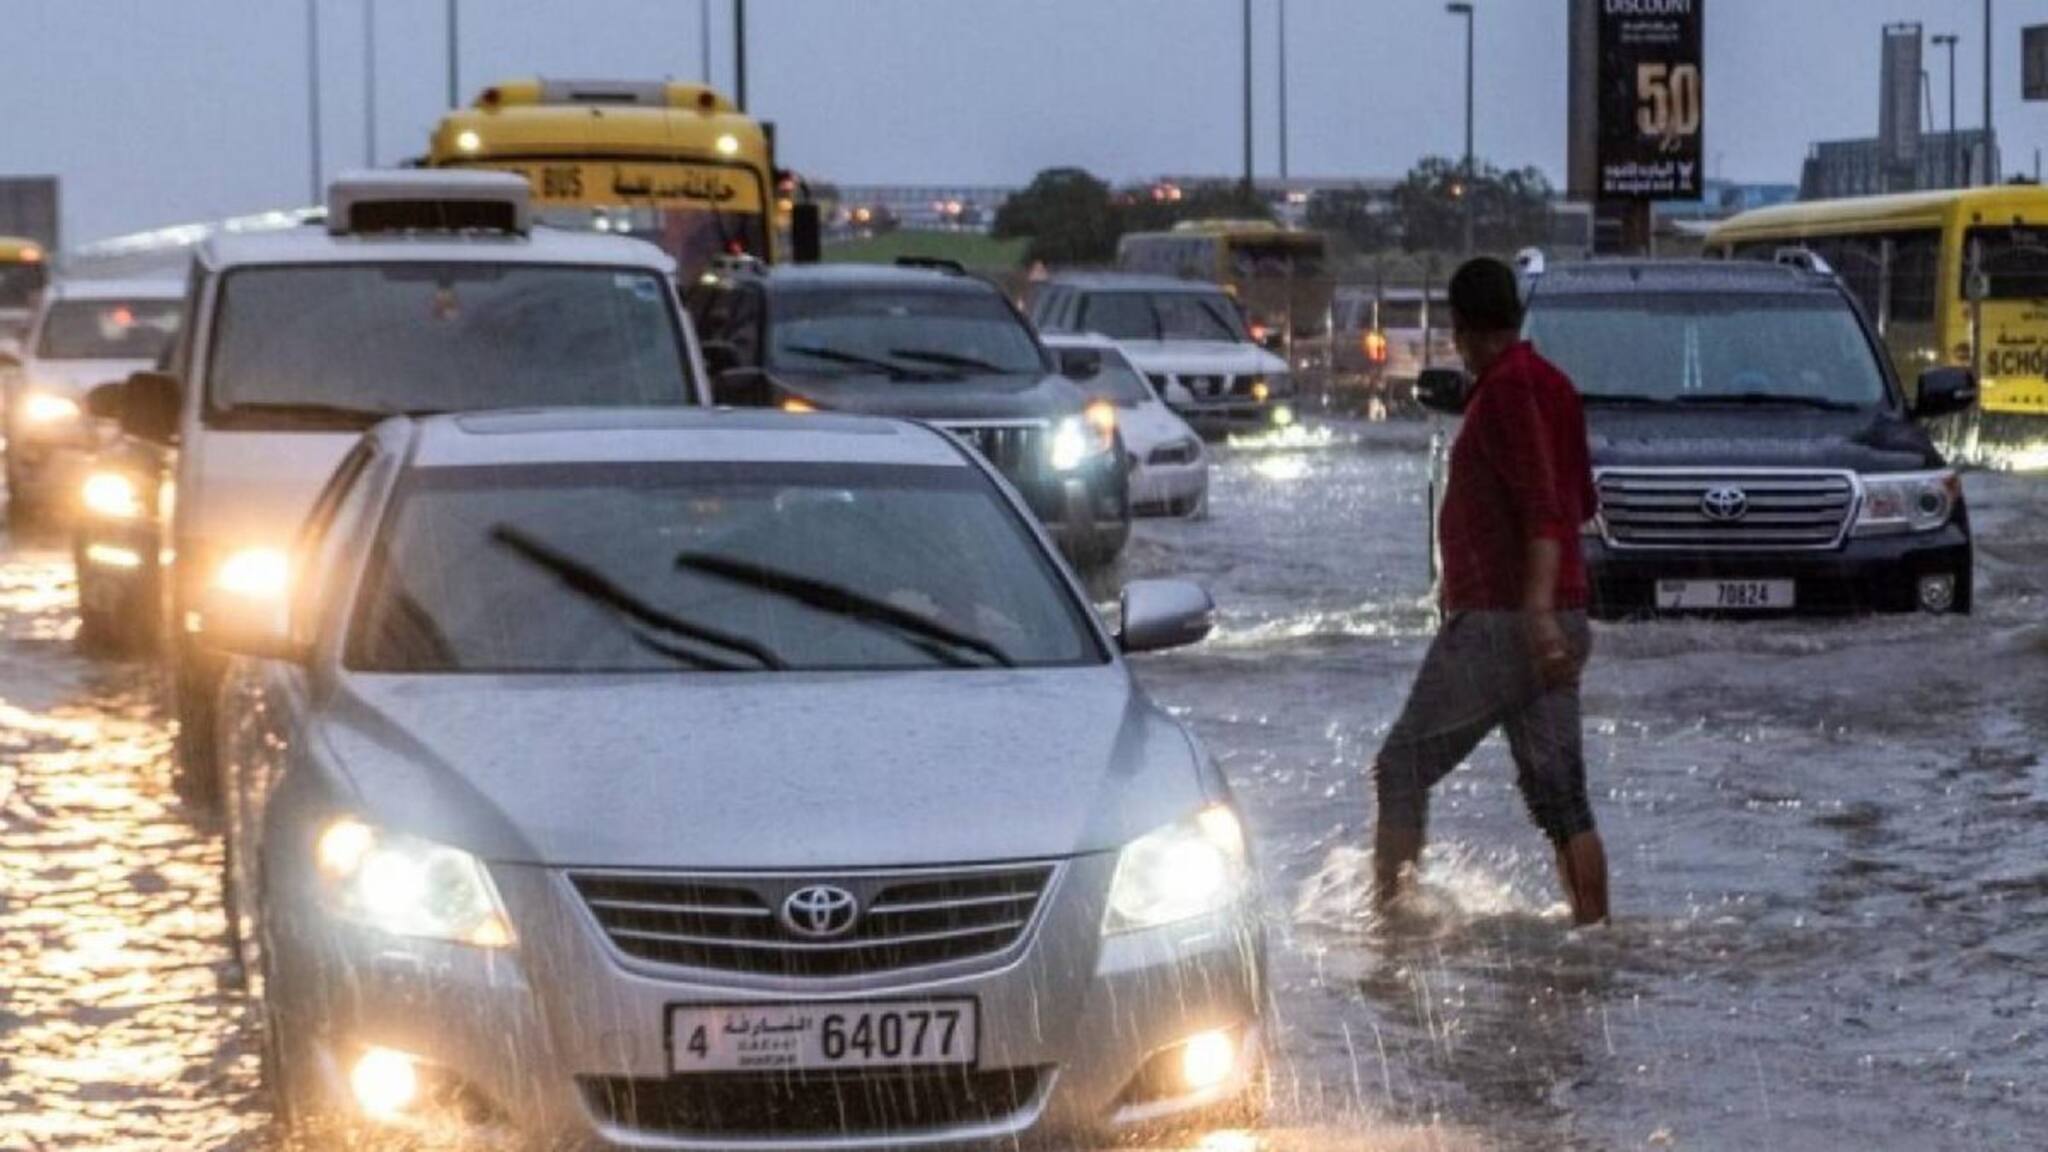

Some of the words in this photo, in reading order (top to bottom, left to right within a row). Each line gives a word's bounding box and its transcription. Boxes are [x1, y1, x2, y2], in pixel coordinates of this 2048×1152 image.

[1637, 62, 1700, 135] 50
[543, 167, 583, 198] BUS
[1718, 583, 1768, 604] 70824
[687, 1025, 708, 1058] 4
[822, 1009, 961, 1060] 64077
